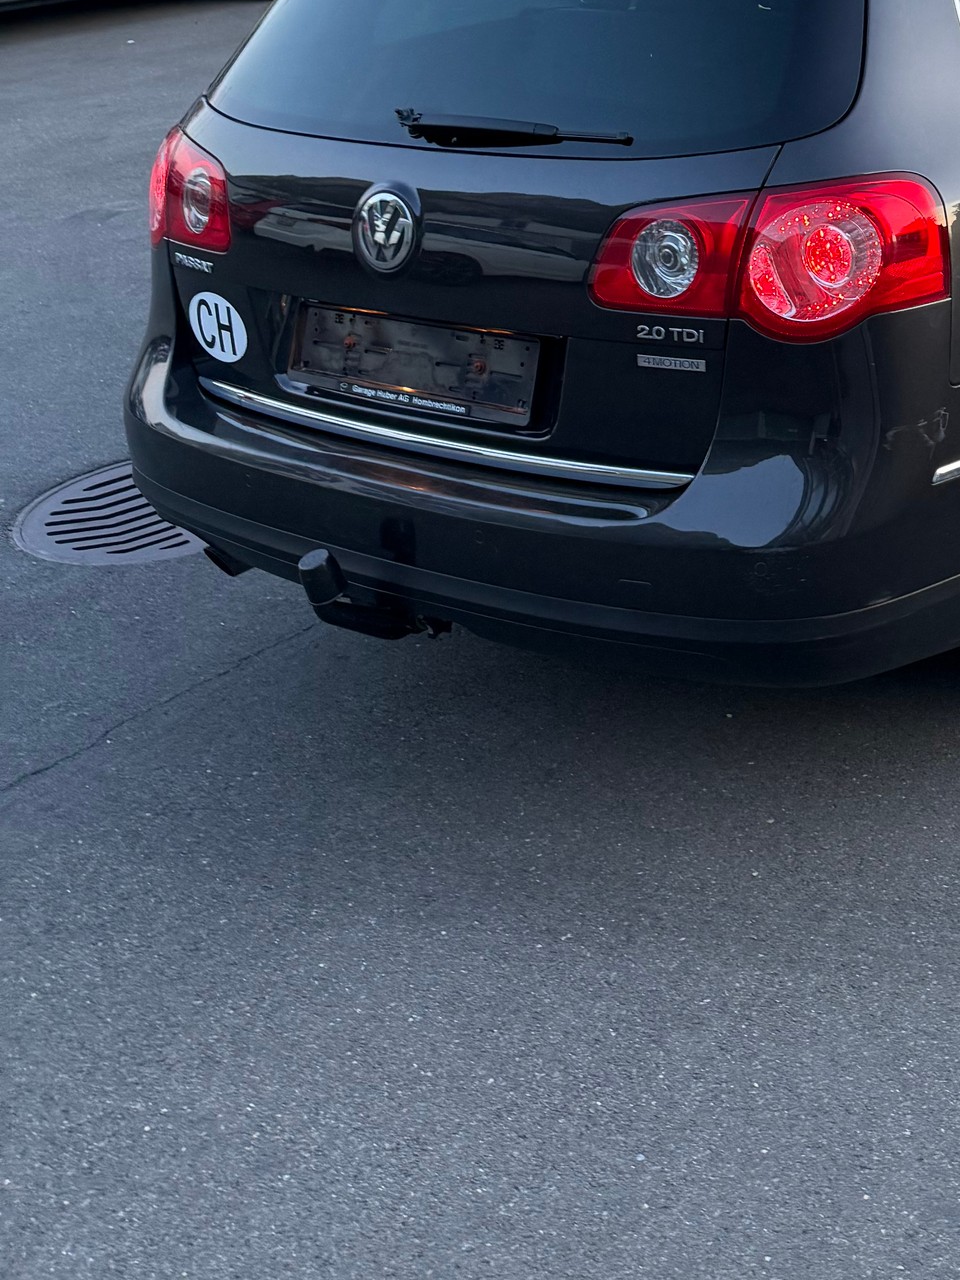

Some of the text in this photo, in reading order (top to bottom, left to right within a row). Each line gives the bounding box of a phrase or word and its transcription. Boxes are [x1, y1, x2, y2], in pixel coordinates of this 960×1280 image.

[360, 192, 412, 270] VW
[175, 252, 214, 273] PASSAT
[197, 299, 237, 355] CH
[643, 357, 700, 370] 4MOTION
[352, 384, 376, 397] Garage
[376, 390, 397, 400] Huber
[397, 393, 410, 403] AG
